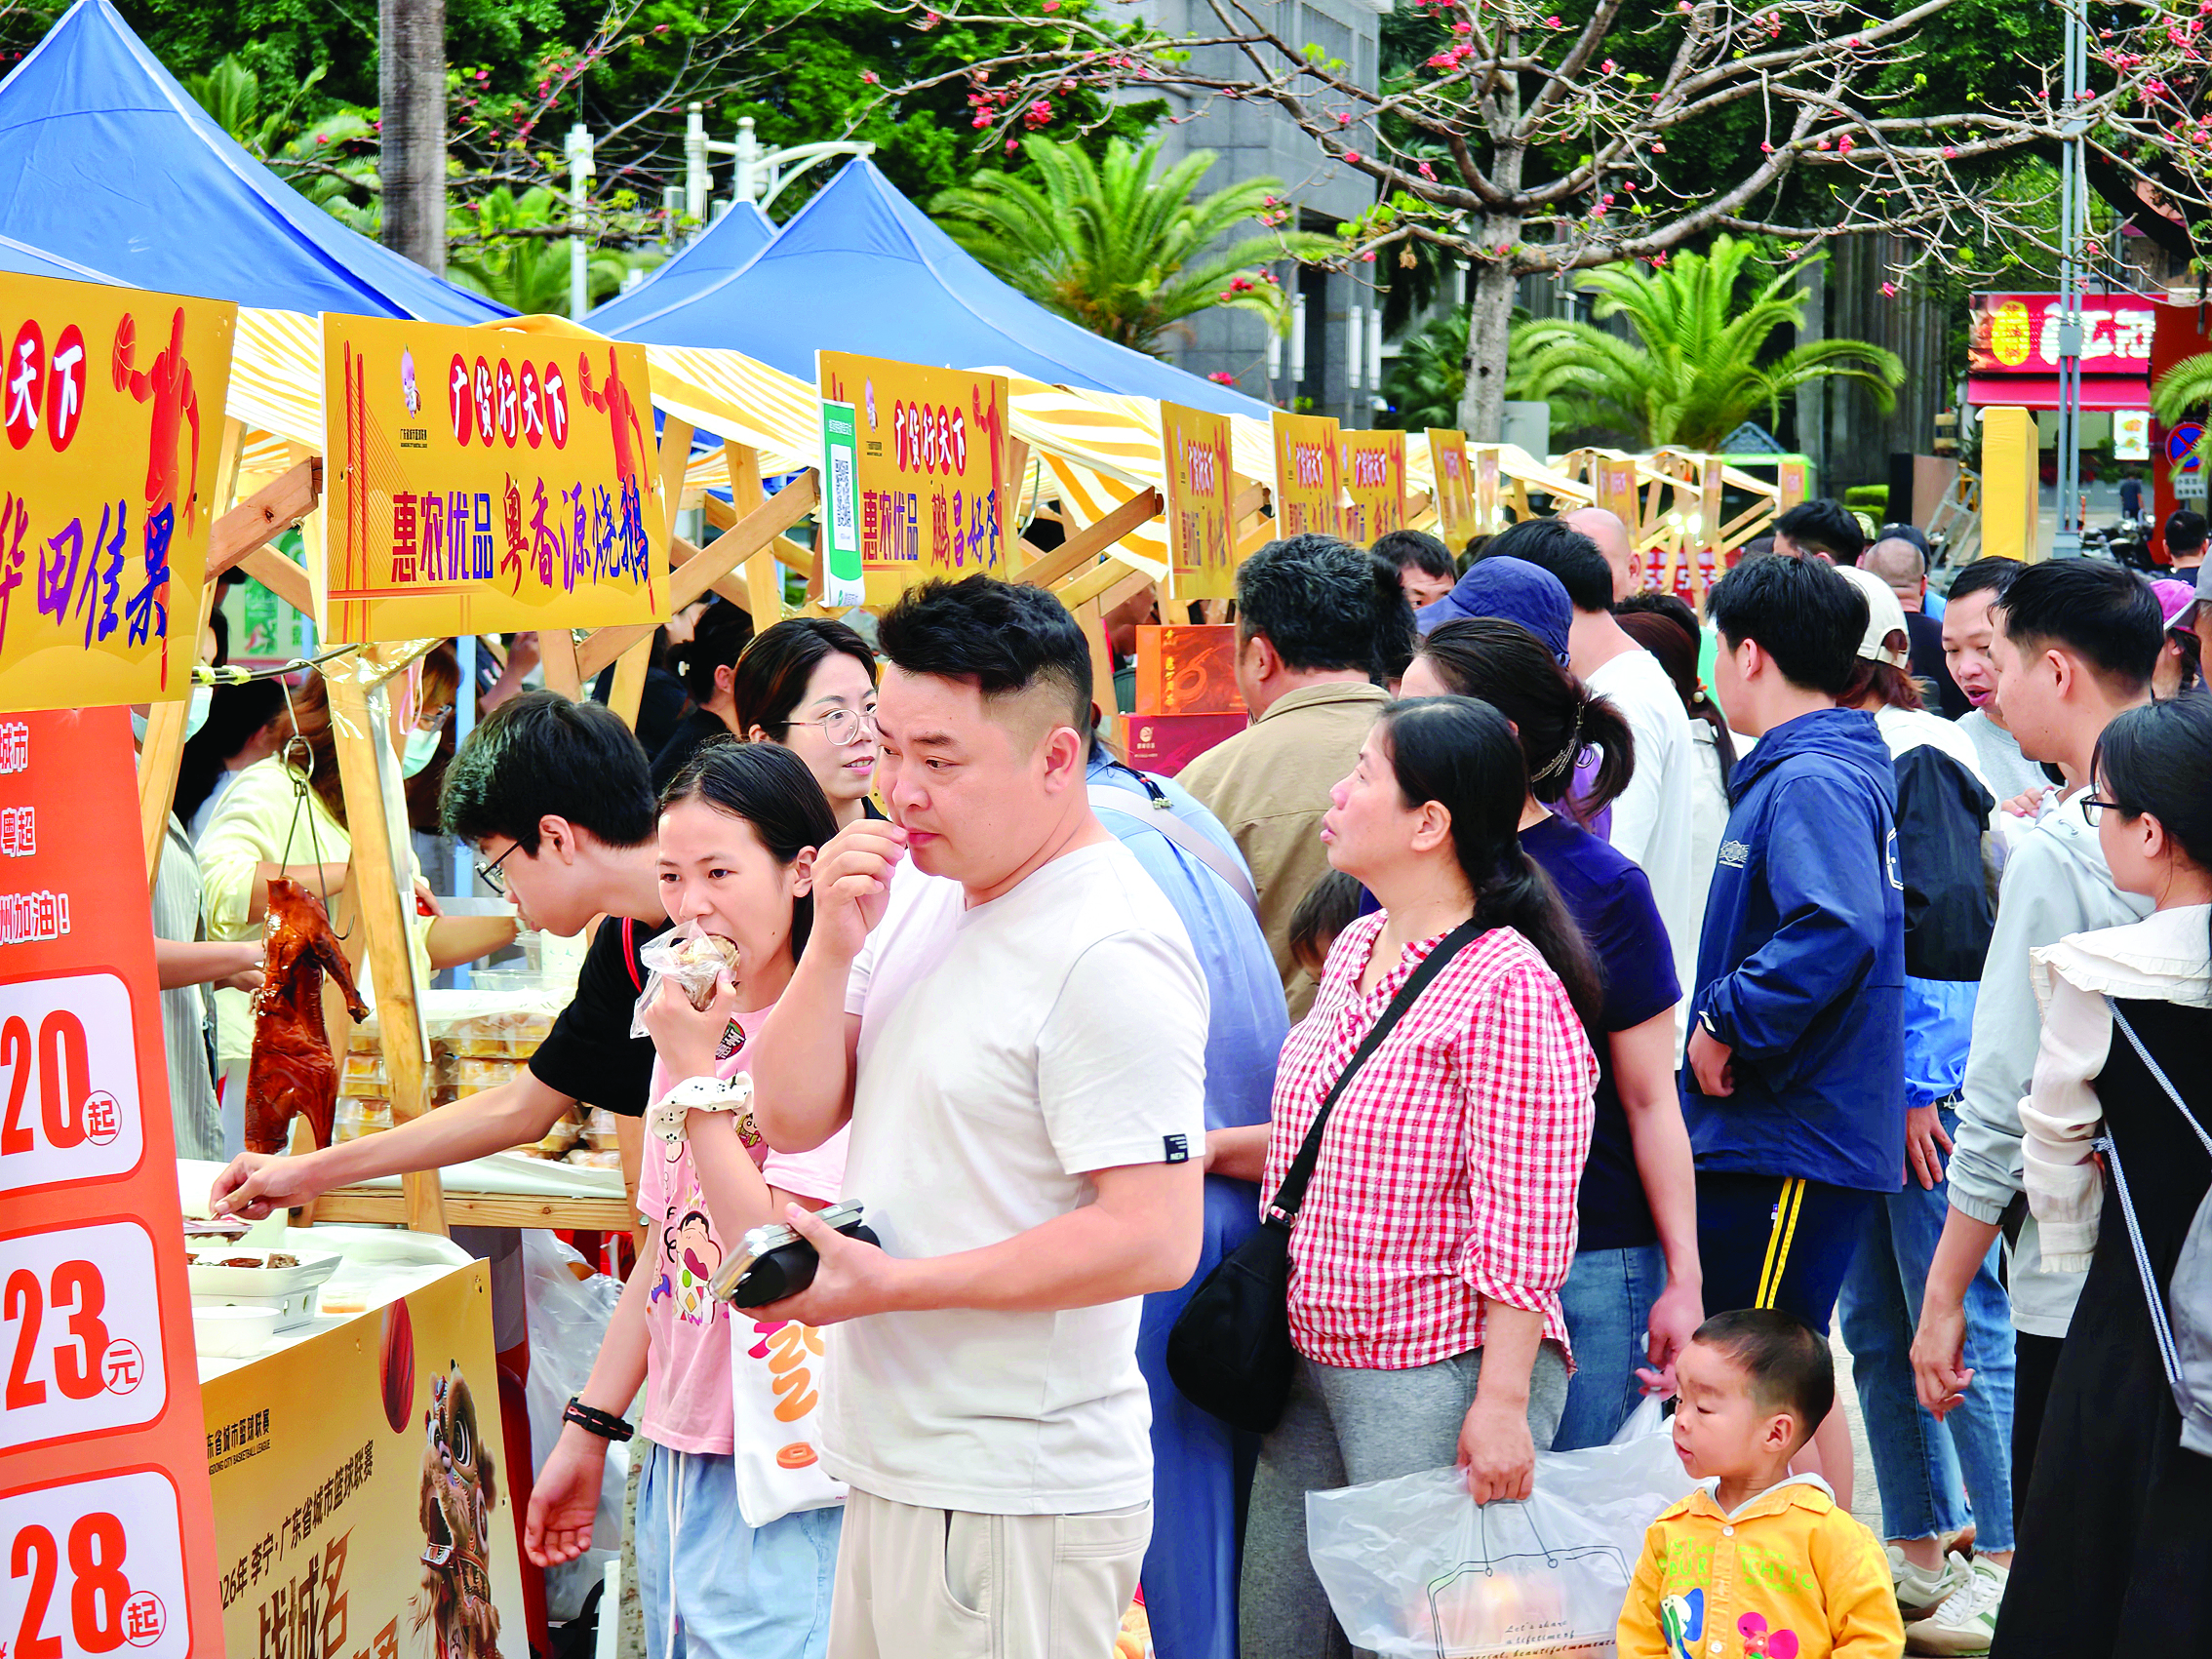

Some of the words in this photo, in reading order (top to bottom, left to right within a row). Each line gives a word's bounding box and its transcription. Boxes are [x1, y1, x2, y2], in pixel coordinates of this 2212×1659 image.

[6, 339, 84, 439] 天下
[452, 365, 566, 441] 广货行天下
[894, 408, 965, 470] 广货行天下
[391, 491, 494, 582] 惠农优品
[500, 472, 650, 597] 粤香源烧鹅
[863, 490, 918, 560] 惠农优品
[0, 491, 175, 652] 华田佳果
[2, 808, 36, 857] 粤超
[1513, 1645, 1565, 1658] beautiful
[1568, 1639, 1616, 1650] moments
[1517, 1633, 1561, 1644] lifetime
